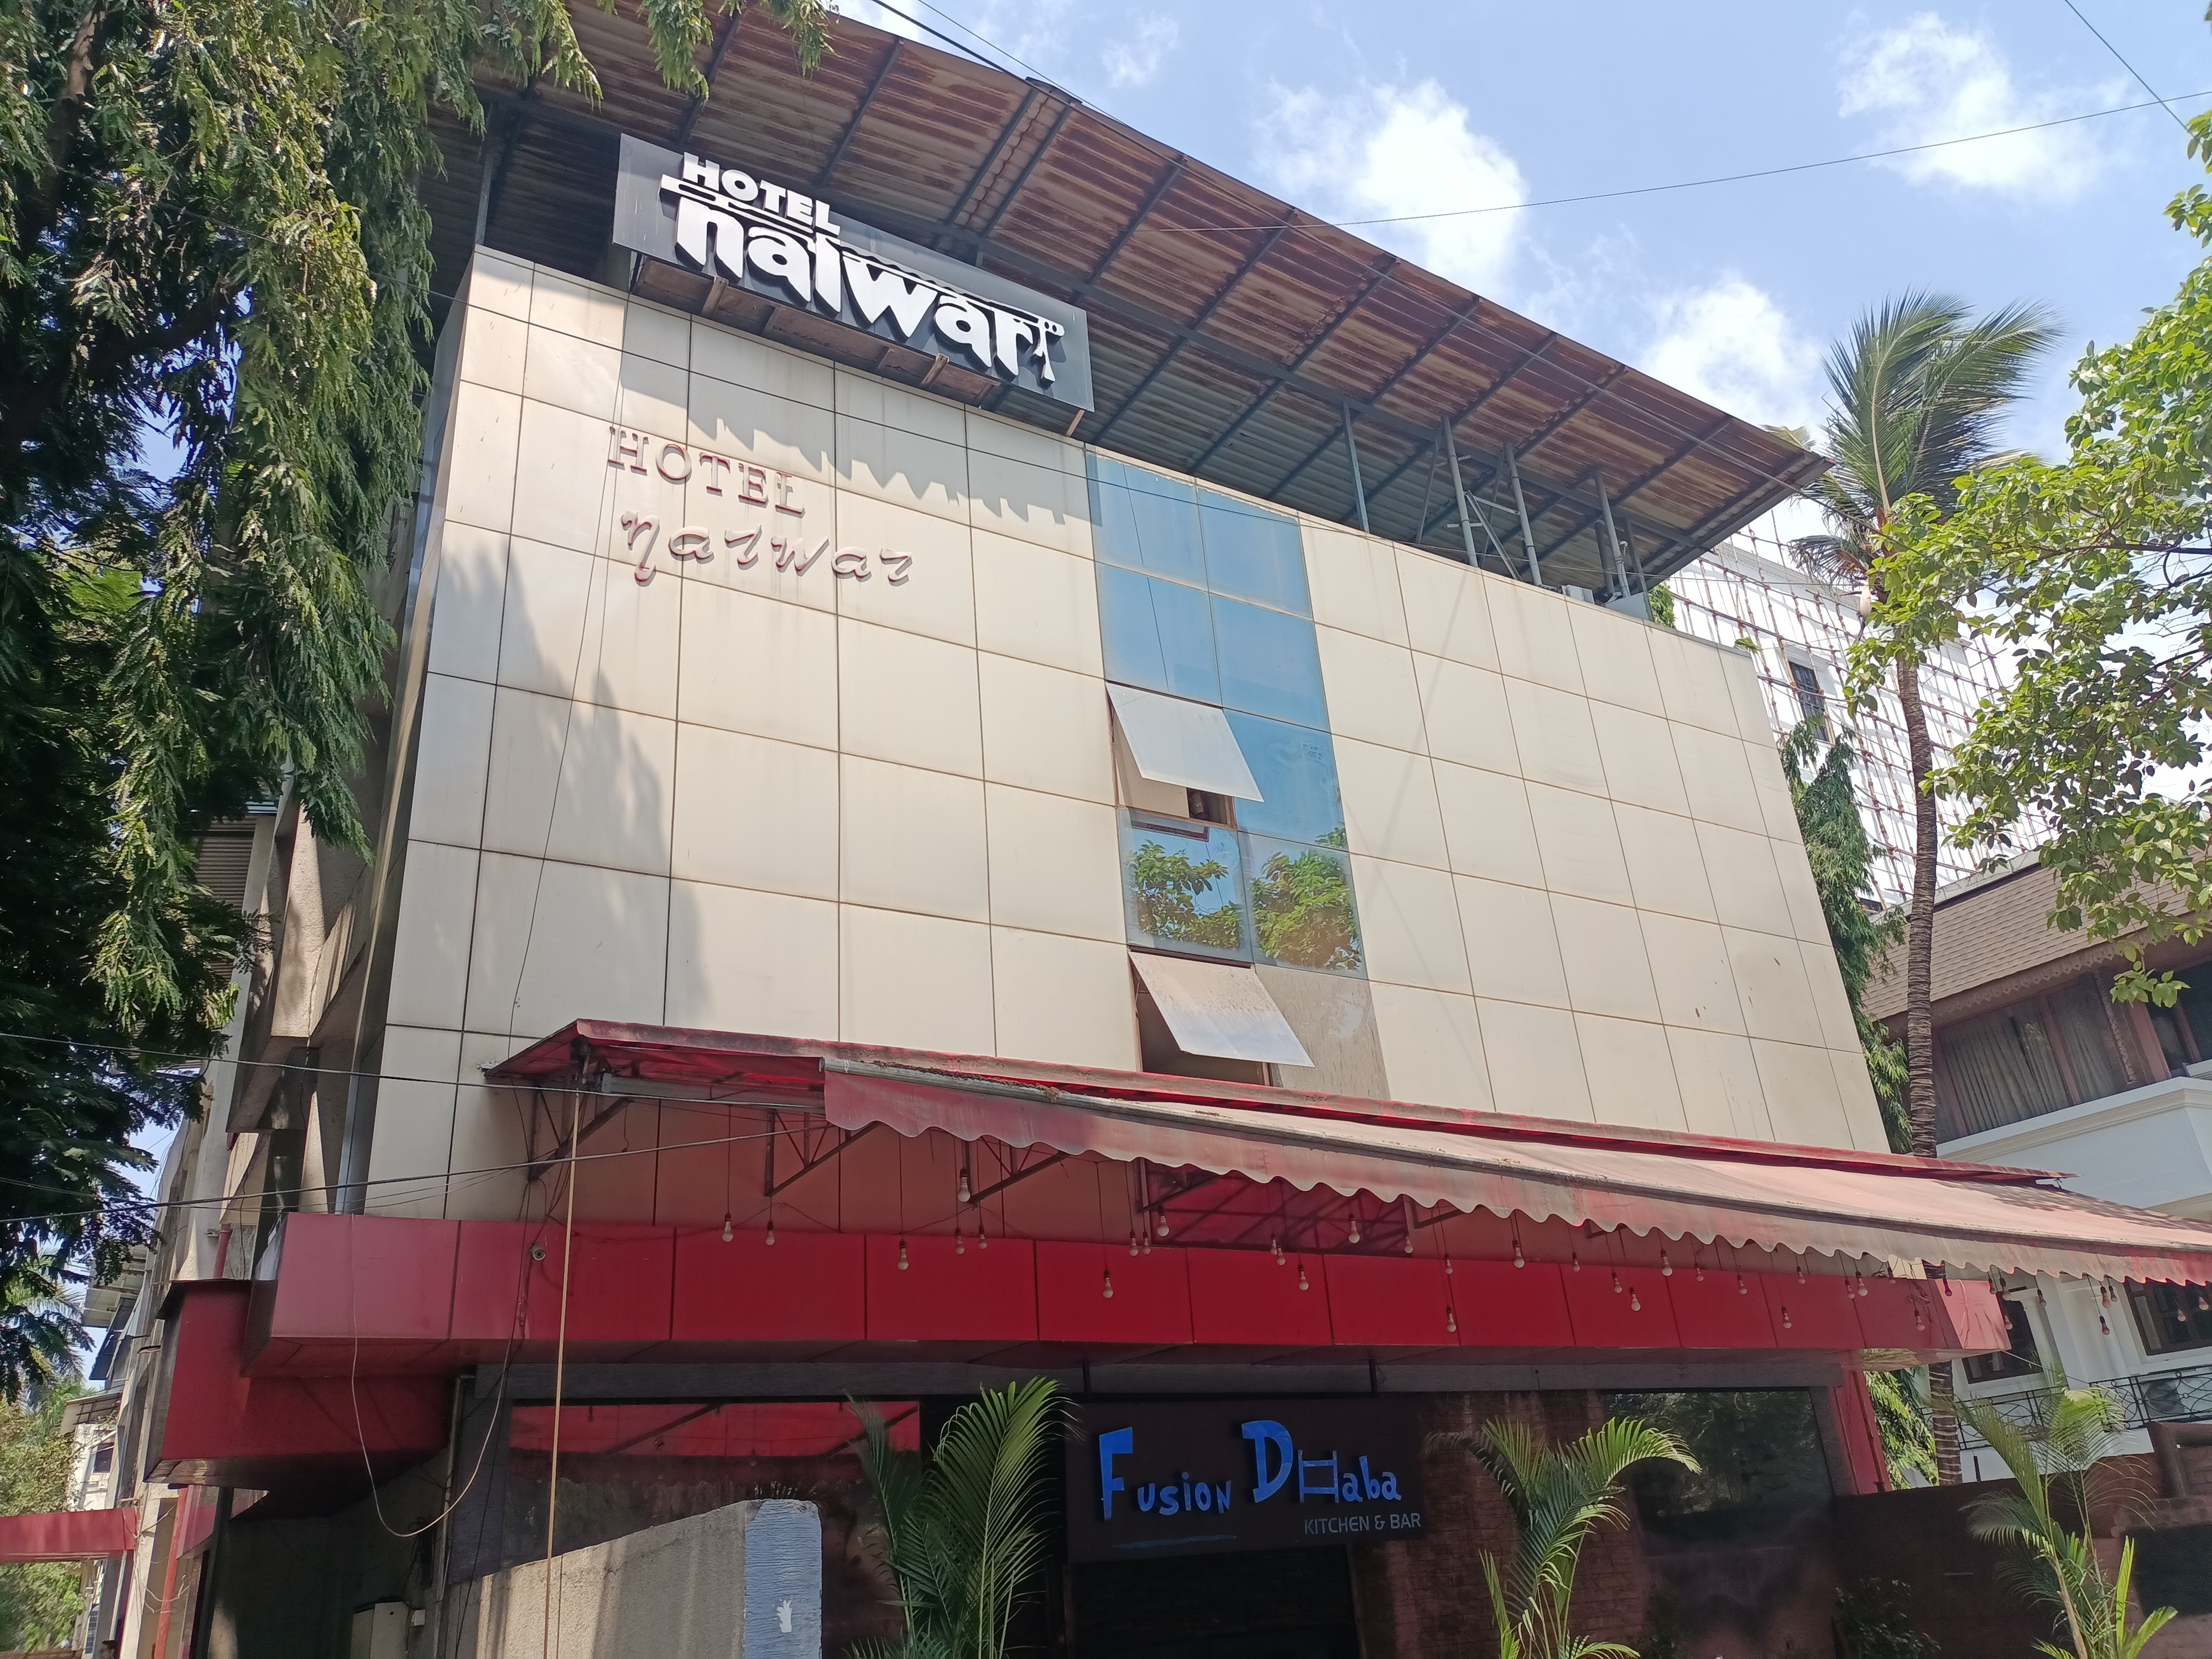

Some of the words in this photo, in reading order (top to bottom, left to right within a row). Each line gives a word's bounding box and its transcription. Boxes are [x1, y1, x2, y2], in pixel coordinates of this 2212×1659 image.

[682, 152, 841, 235] HOTEL
[608, 426, 805, 518] HOTEL
[1305, 1516, 1370, 1535] KITCHEN
[1375, 1515, 1385, 1530] &
[1390, 1512, 1421, 1530] BAR
